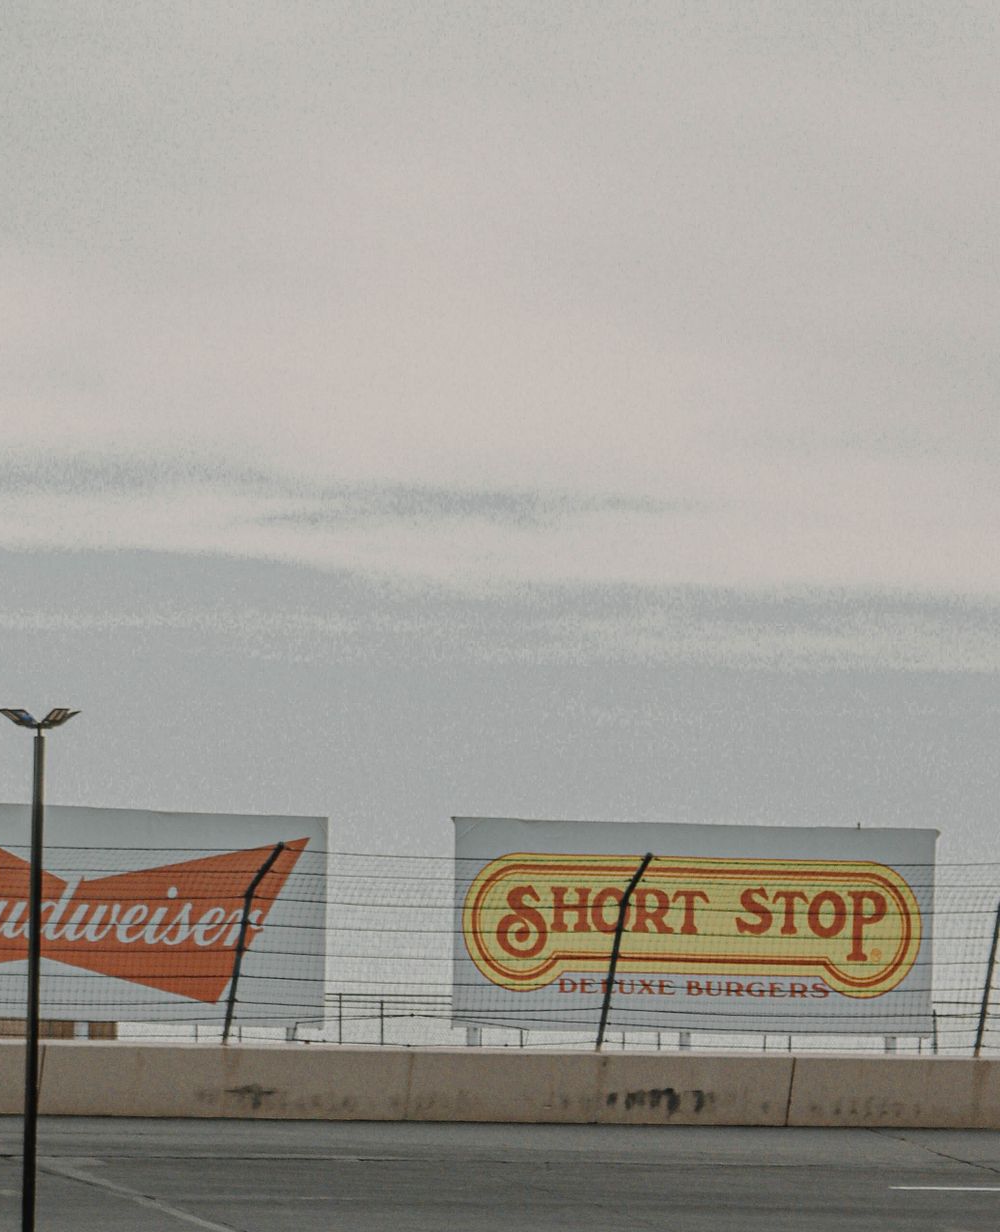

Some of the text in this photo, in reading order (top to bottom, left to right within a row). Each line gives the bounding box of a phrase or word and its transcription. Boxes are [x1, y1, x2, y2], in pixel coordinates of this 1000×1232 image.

[496, 885, 887, 962] SHORT STOP
[686, 980, 830, 998] BURGERS
